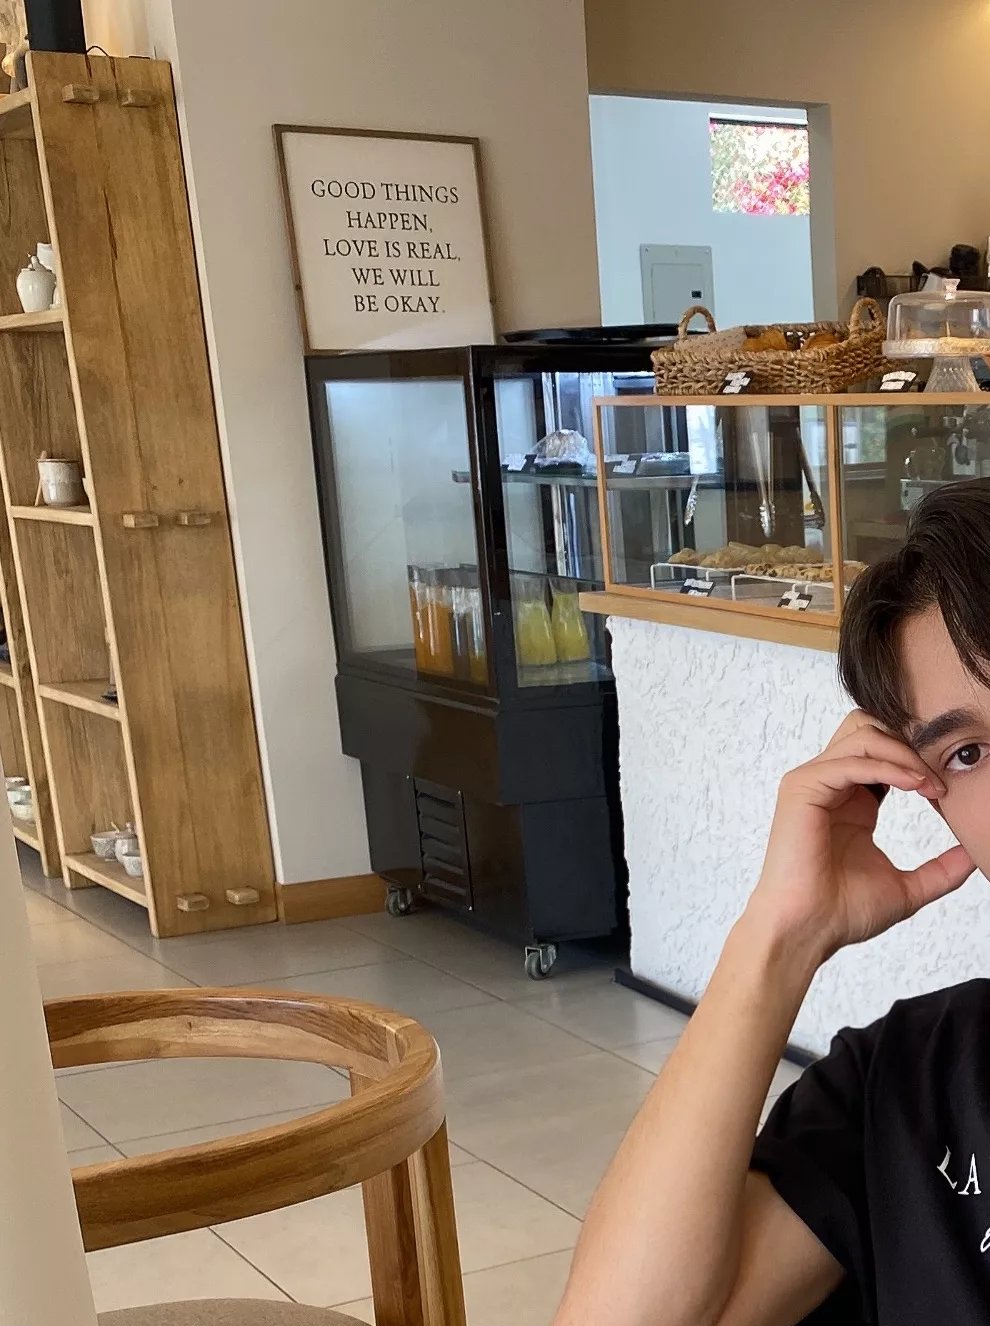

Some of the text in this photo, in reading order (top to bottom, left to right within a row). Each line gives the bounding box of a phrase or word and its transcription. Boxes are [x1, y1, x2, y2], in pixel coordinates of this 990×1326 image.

[311, 179, 459, 204] GOOD THINGS
[346, 210, 433, 233] HAPPEN,
[323, 238, 461, 262] LOVE IS REAL,
[351, 267, 440, 287] WE WILL
[354, 294, 446, 314] BE OKAY.
[937, 1145, 982, 1196] LA
